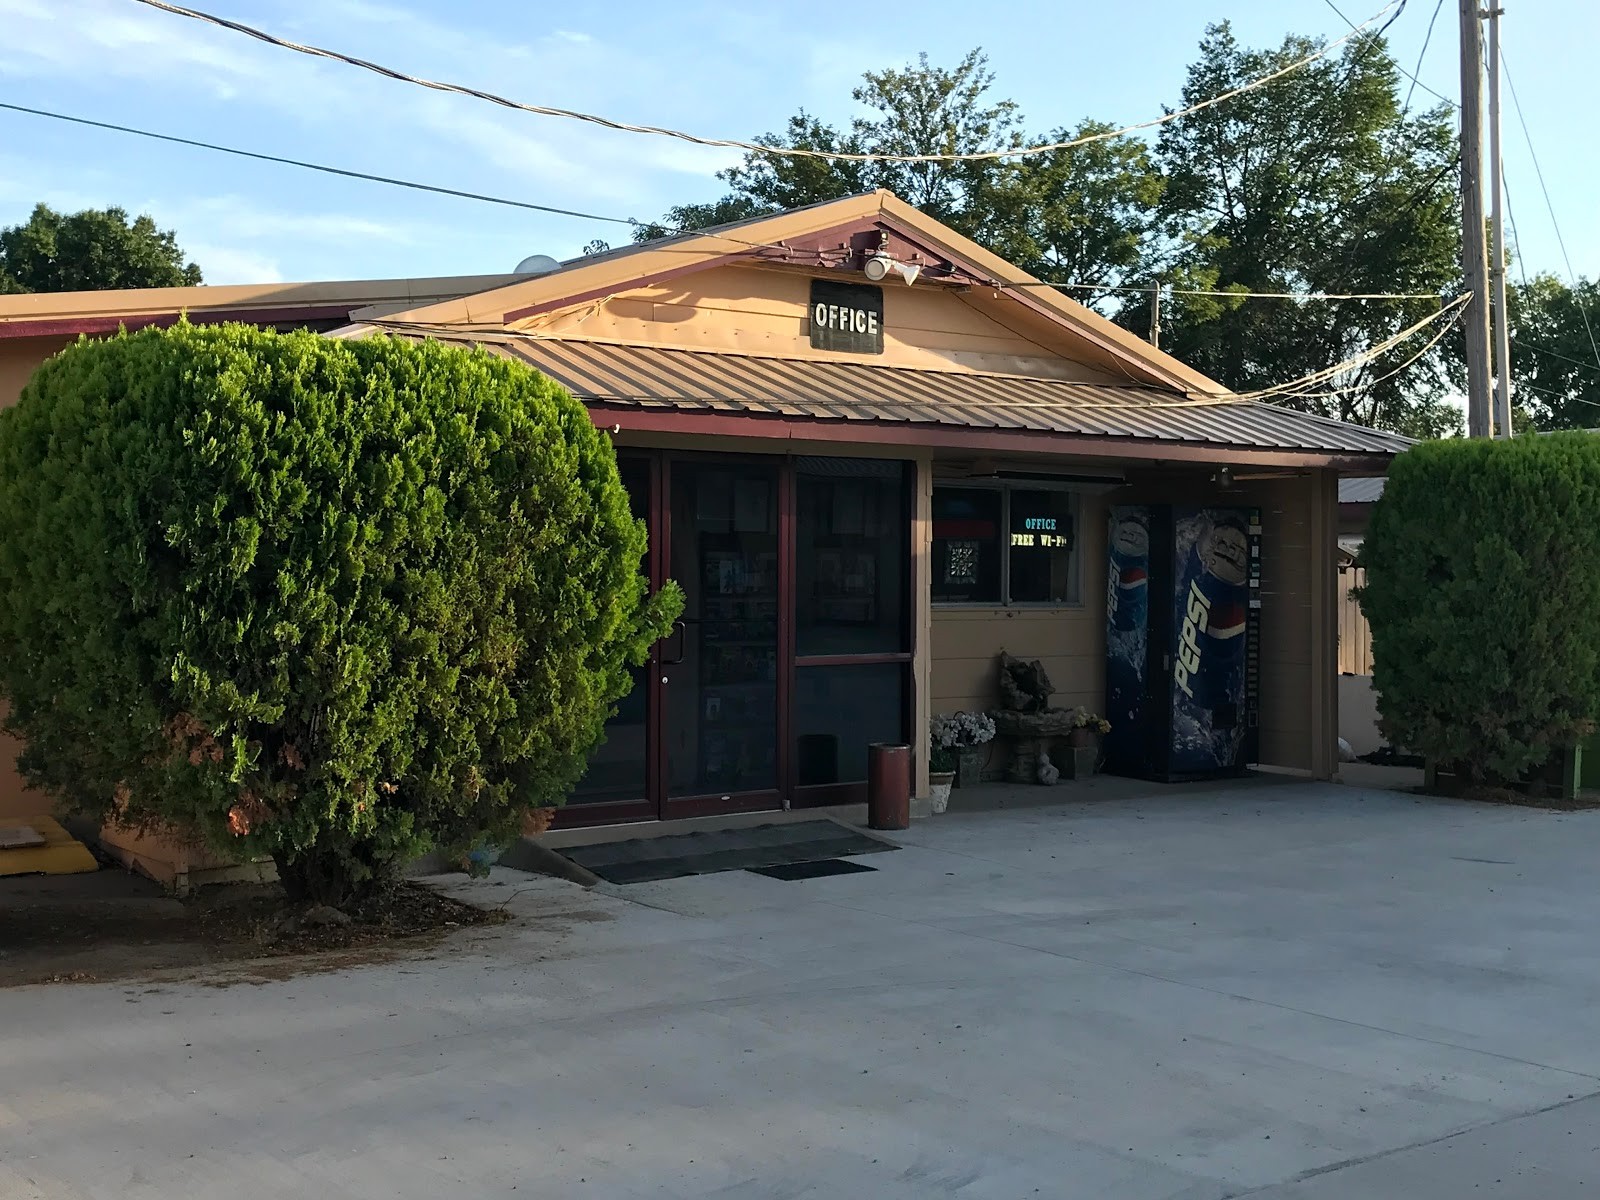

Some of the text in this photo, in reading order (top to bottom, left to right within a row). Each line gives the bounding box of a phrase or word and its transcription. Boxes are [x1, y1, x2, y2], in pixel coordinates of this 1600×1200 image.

[815, 303, 878, 335] OFFICE
[1010, 533, 1034, 547] FREE
[1025, 518, 1057, 530] OFFICE
[1106, 556, 1121, 626] PEPSI
[1174, 578, 1212, 699] PEPSI
